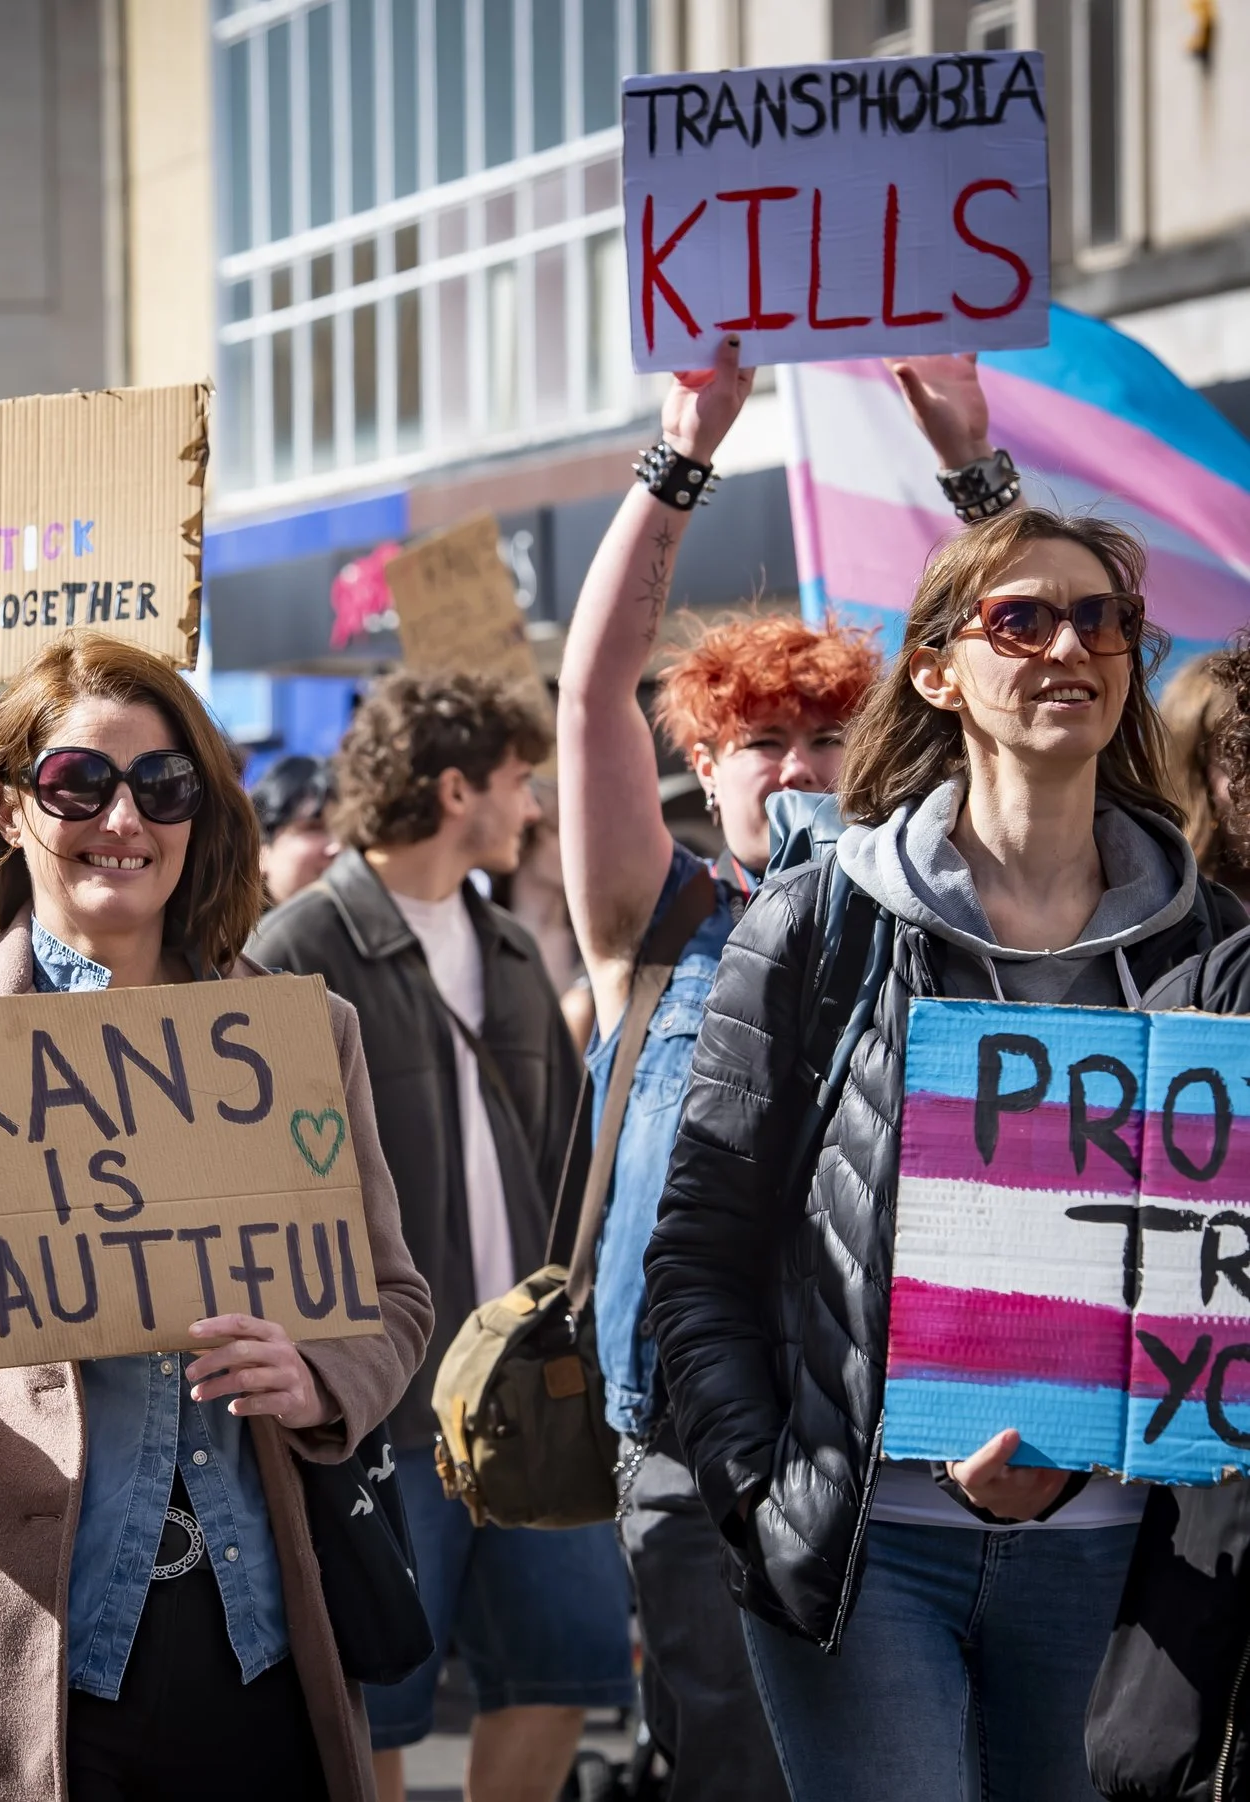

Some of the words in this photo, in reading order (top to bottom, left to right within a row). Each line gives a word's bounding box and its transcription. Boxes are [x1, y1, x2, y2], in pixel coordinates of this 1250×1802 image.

[626, 55, 1047, 157] TRANSPHOBIA
[641, 178, 1032, 356] KILLS
[973, 1032, 1250, 1182] PRO
[43, 1148, 145, 1225] IS
